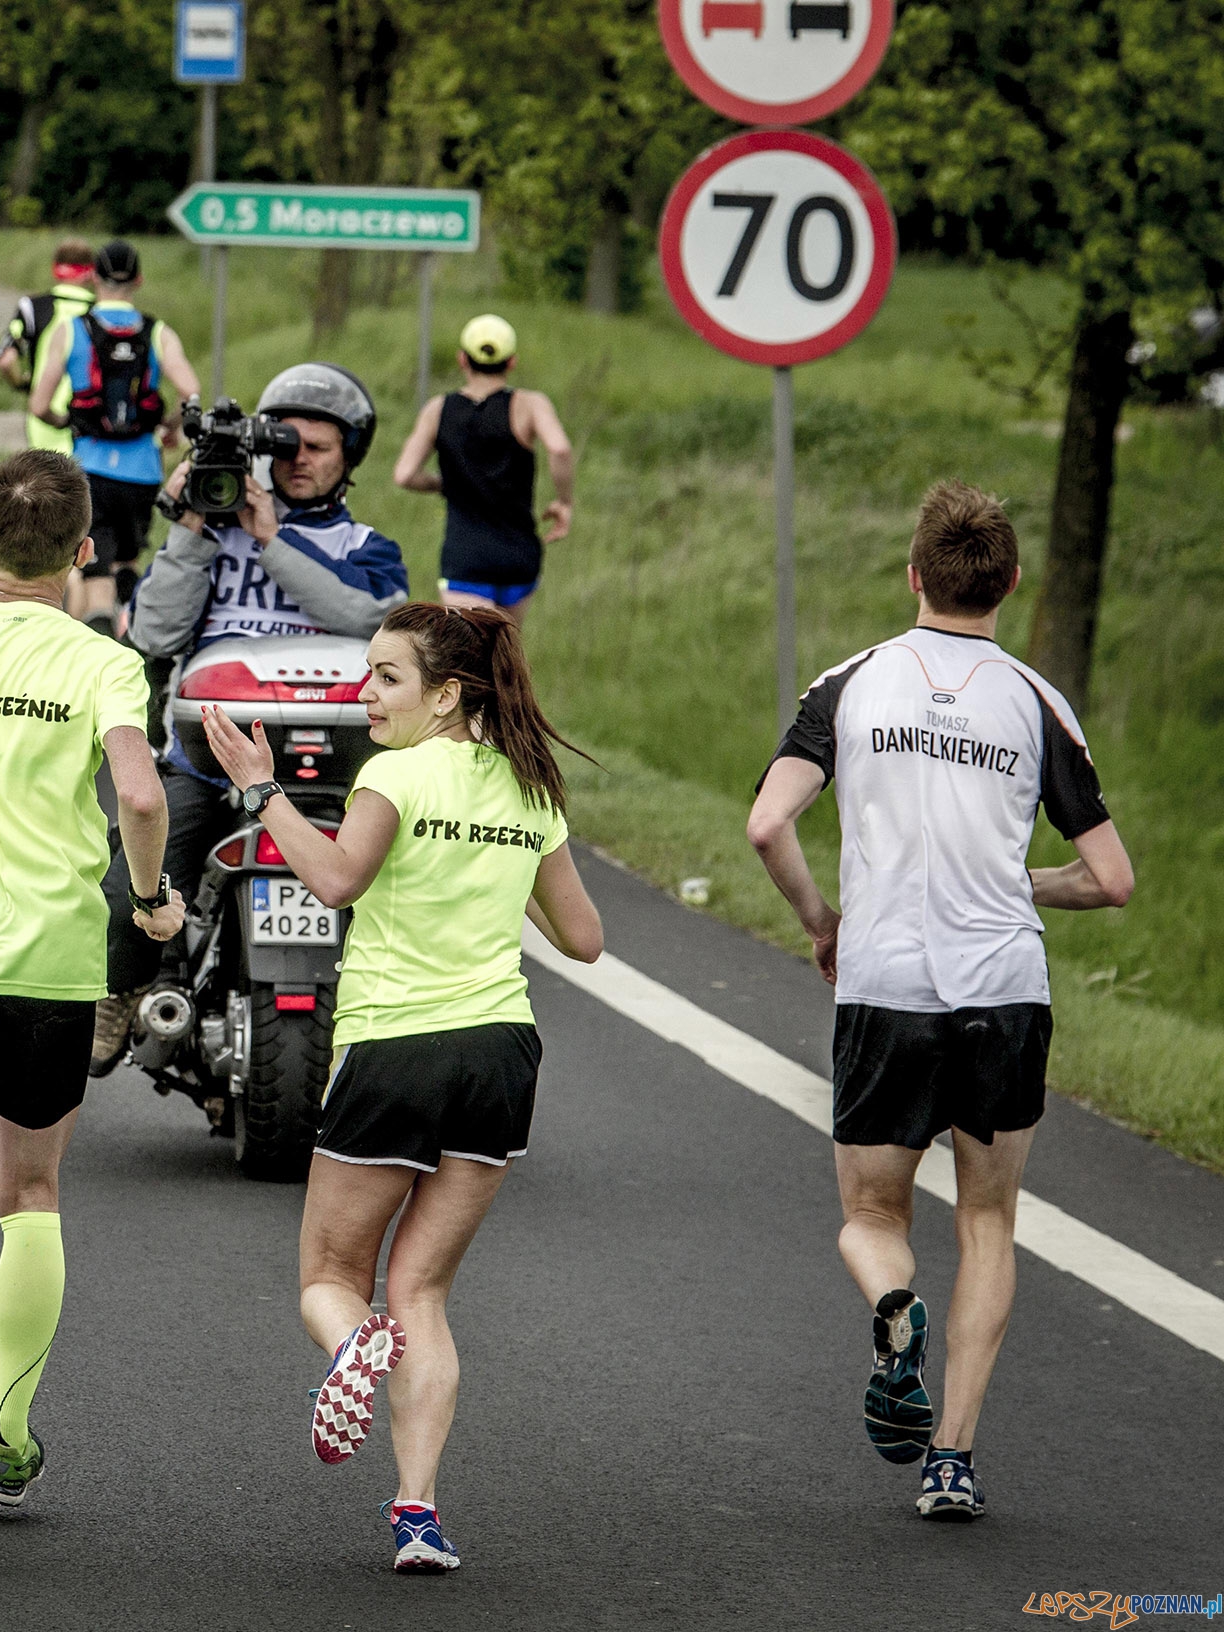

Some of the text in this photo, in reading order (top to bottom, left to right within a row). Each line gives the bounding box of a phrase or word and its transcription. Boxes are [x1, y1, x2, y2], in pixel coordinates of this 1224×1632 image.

[269, 199, 466, 239] Moraczewo
[712, 193, 855, 302] 70
[926, 710, 970, 733] TOMASZ
[872, 727, 1020, 777] DANIELKIEWICZ
[413, 818, 461, 841] OTK
[260, 915, 330, 936] 4028
